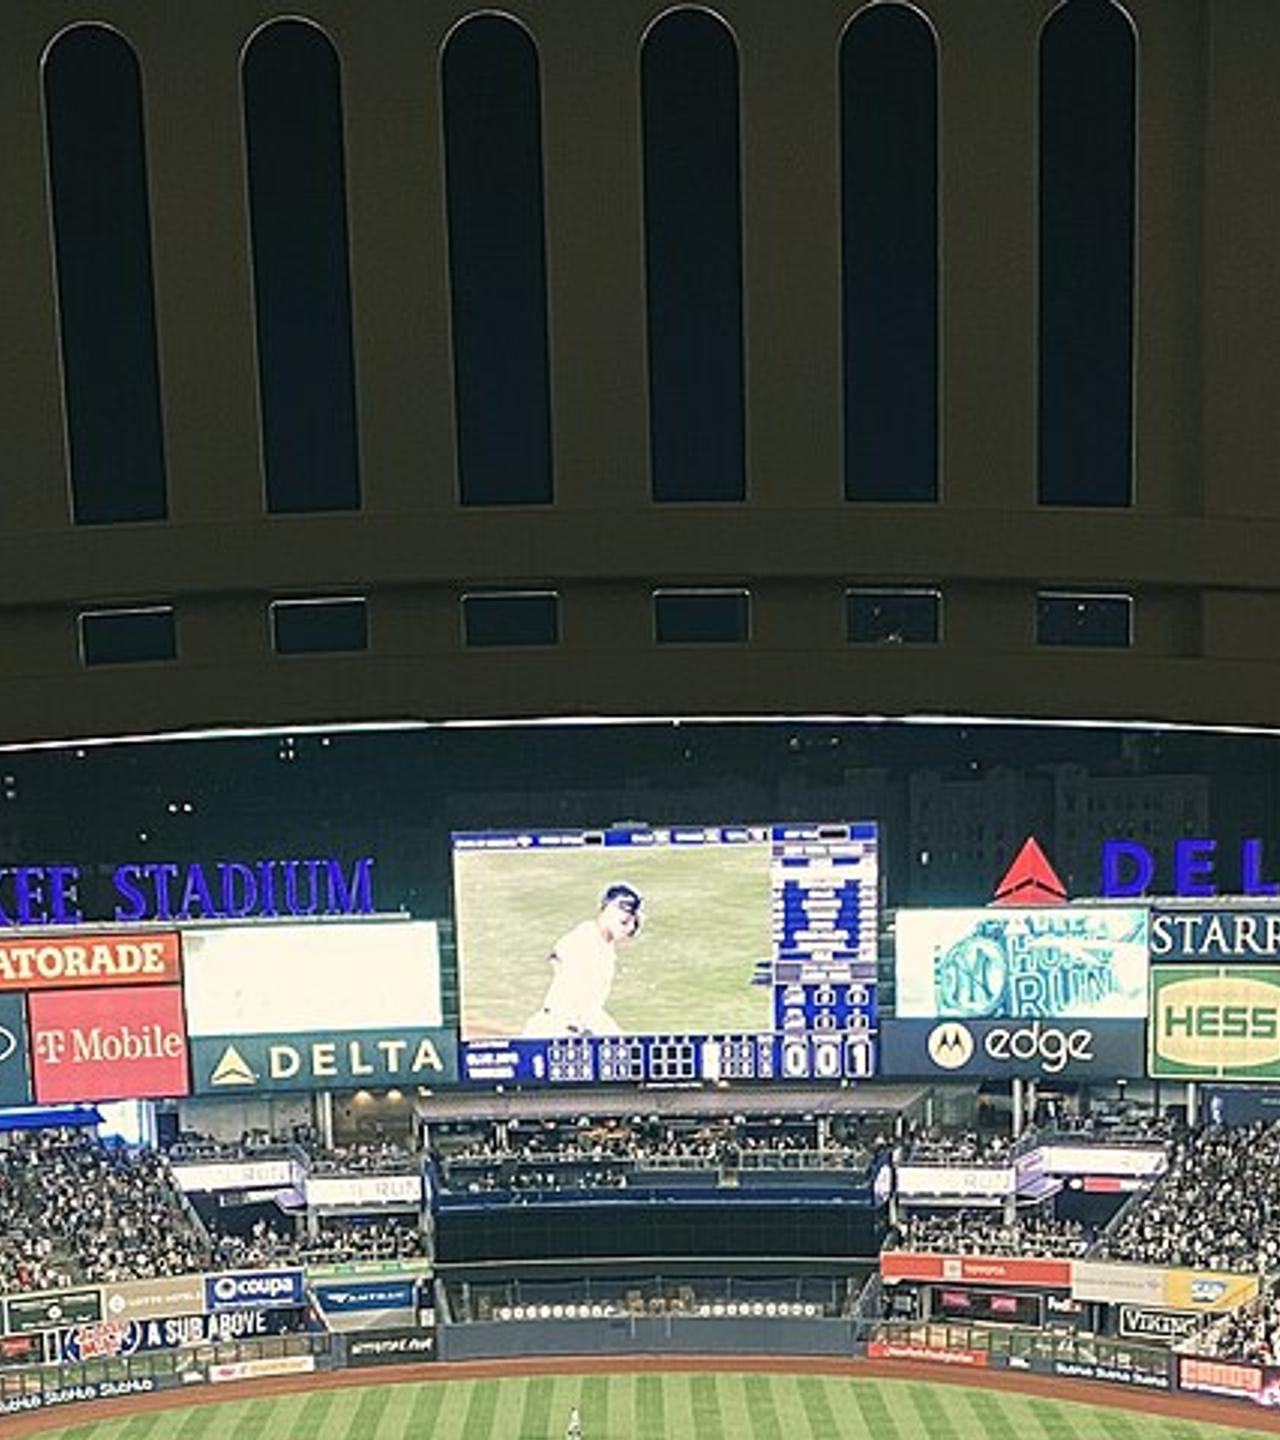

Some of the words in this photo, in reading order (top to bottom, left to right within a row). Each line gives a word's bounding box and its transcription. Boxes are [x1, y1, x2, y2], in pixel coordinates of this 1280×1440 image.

[113, 857, 375, 921] STADIUM
[1165, 1005, 1278, 1038] HESS
[269, 1038, 444, 1080] DELTA
[984, 1020, 1094, 1073] edge
[239, 1277, 294, 1297] coupa
[148, 1325, 162, 1347] A
[165, 1318, 205, 1344] SUB
[207, 1310, 268, 1339] ABOVE
[1126, 1310, 1198, 1334] VIKING
